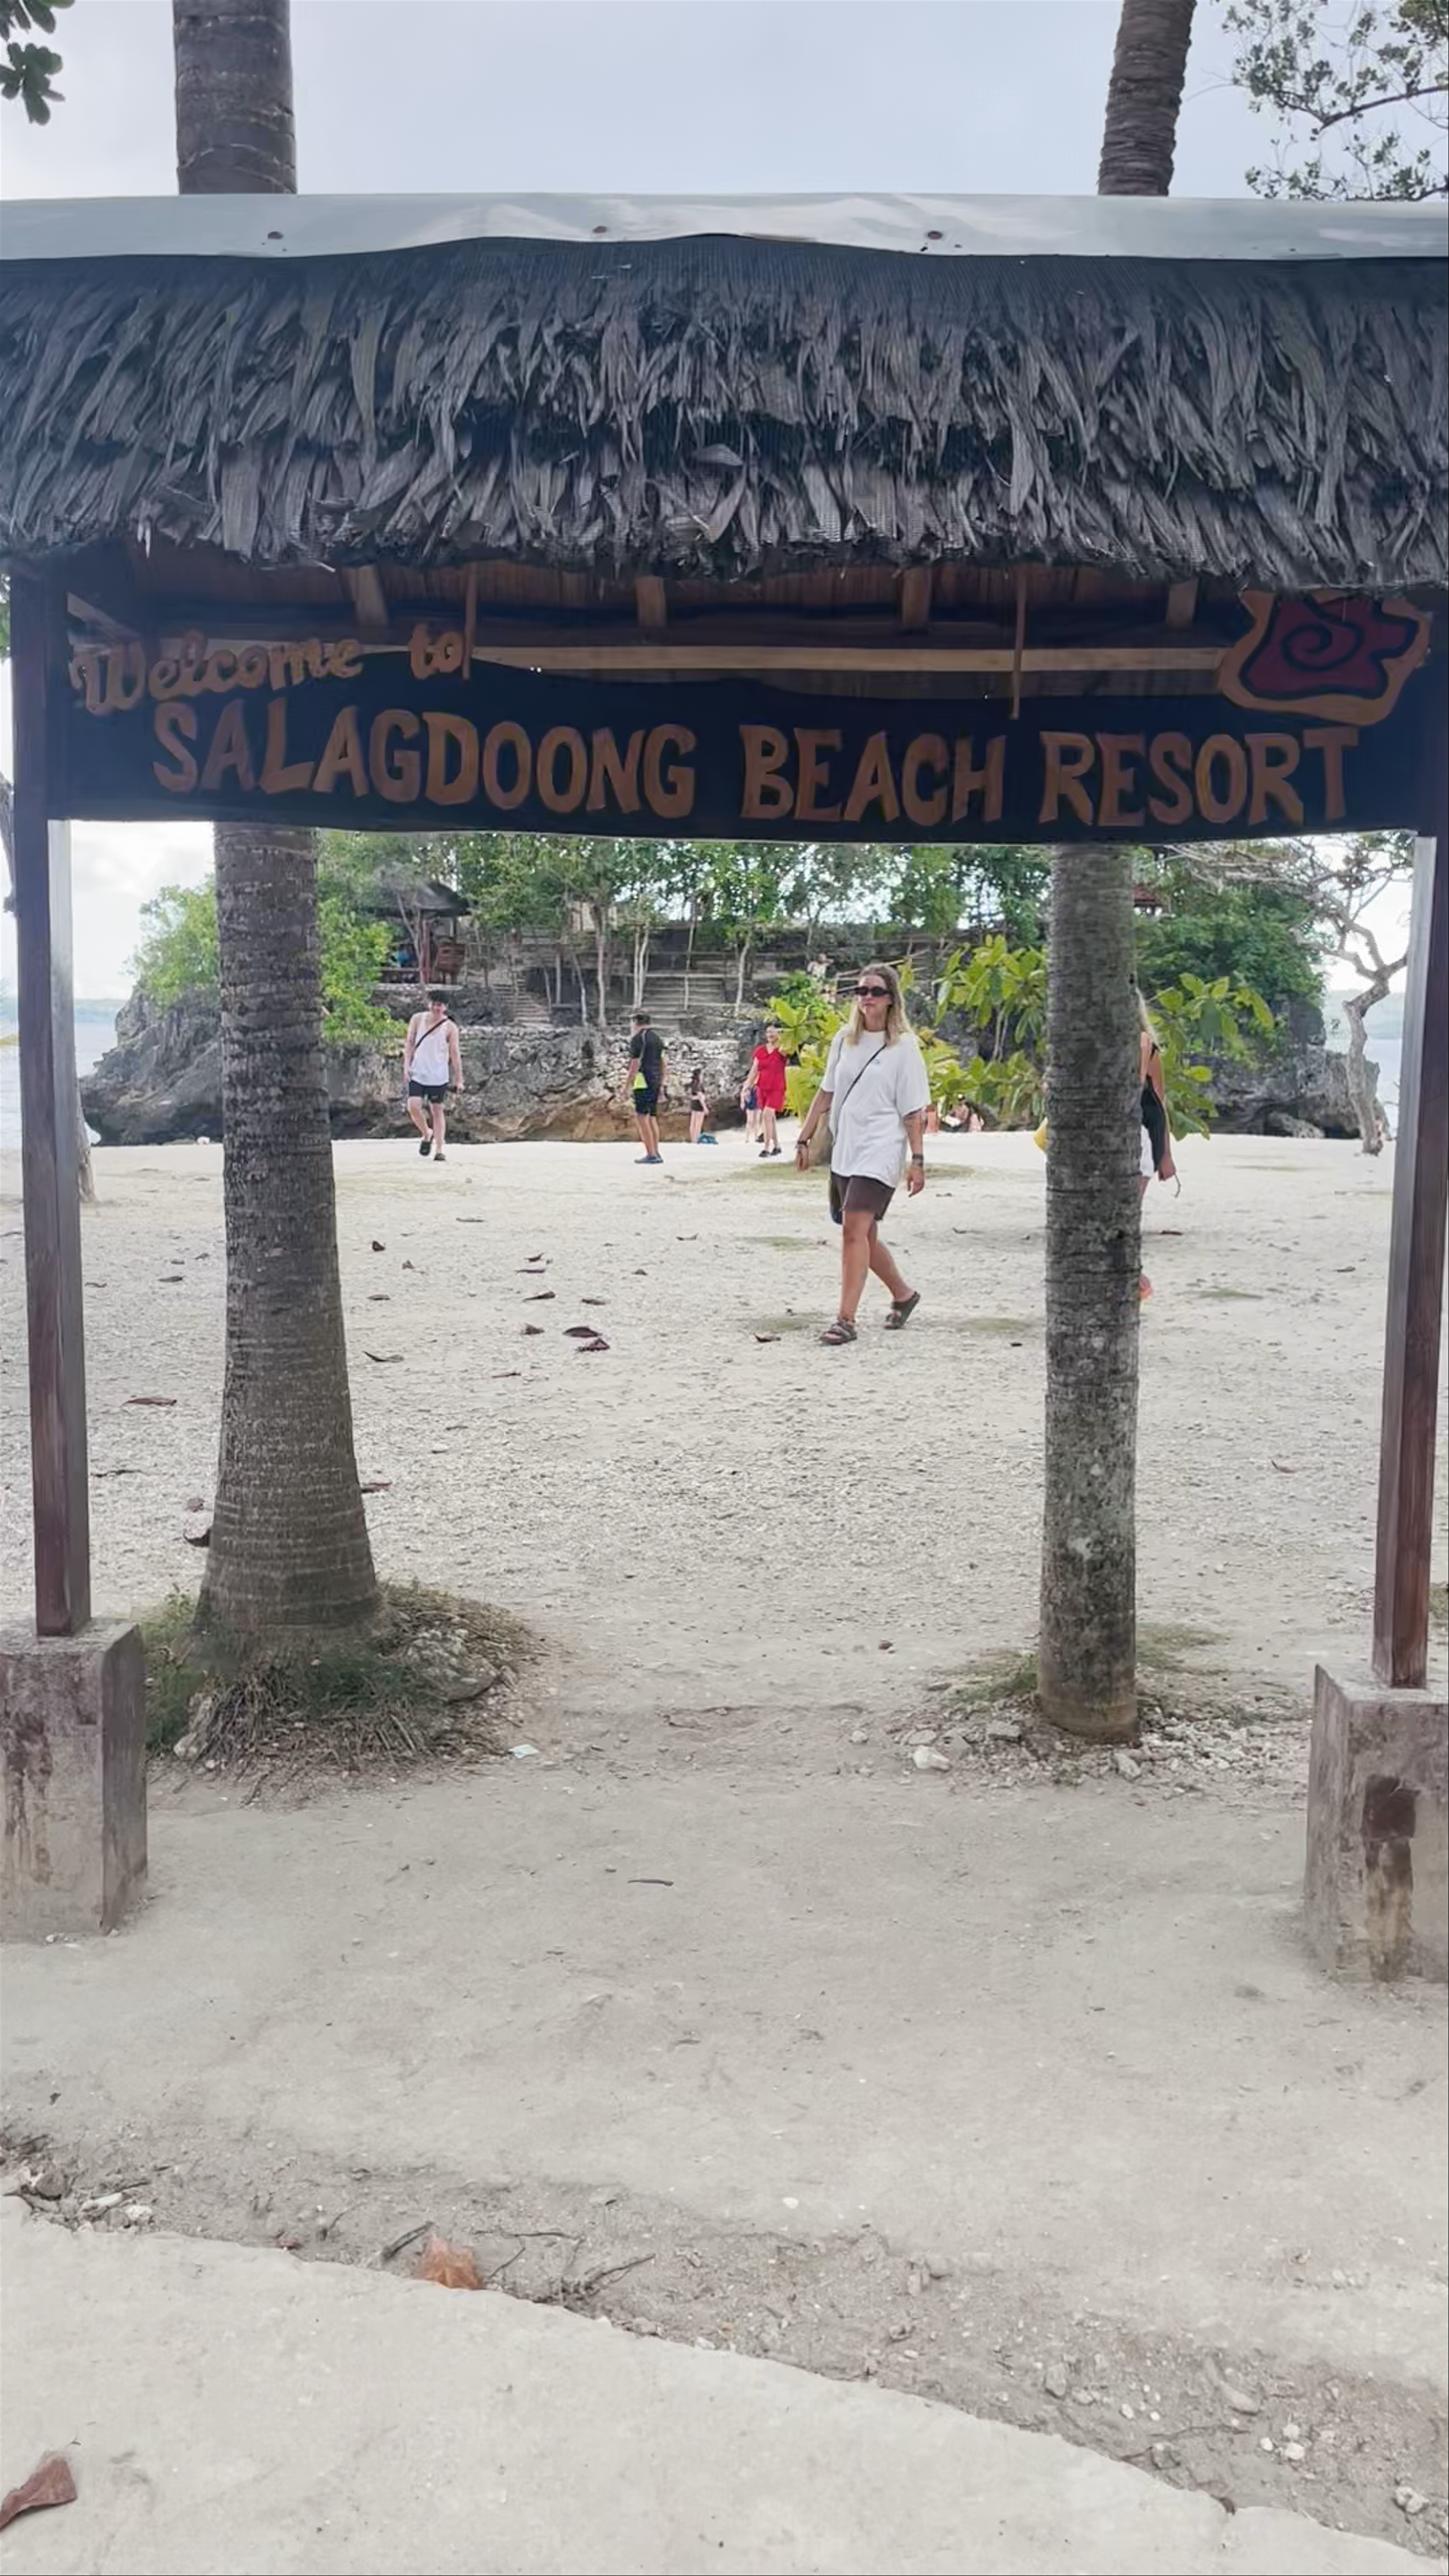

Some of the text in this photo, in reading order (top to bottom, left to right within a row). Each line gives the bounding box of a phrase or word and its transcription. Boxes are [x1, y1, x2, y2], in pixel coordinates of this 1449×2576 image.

[68, 623, 466, 716] Welcome to
[153, 698, 1358, 826] SALAGDOONG BEACH RESORT
